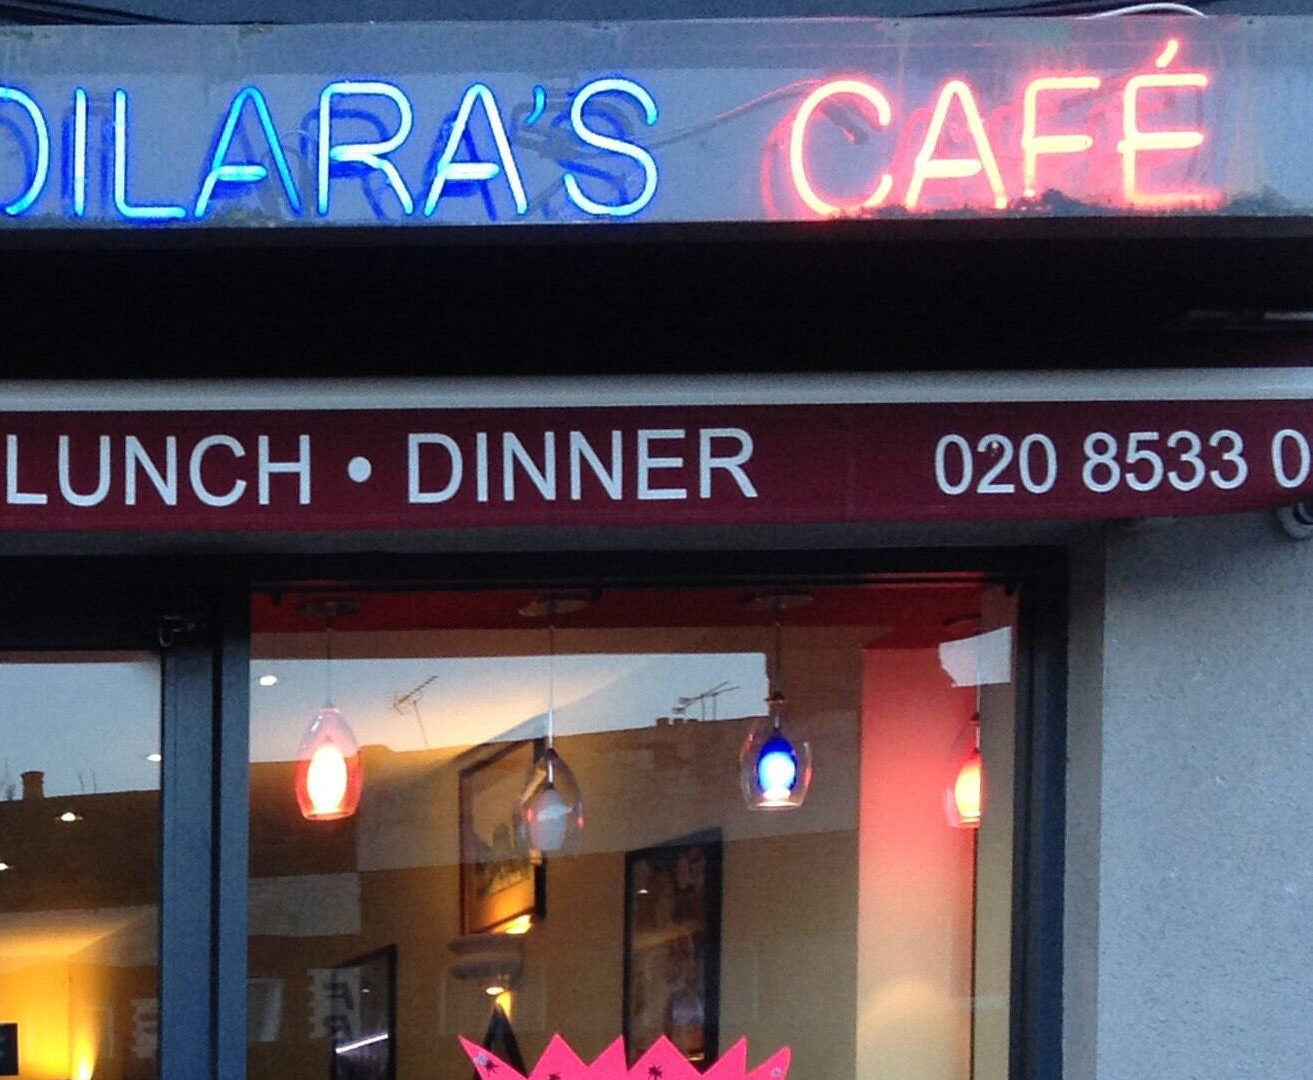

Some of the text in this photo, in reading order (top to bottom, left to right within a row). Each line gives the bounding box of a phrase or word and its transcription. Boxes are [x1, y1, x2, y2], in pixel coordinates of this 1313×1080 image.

[788, 38, 1220, 217] CAFÉ
[4, 432, 313, 508] LUNCH
[407, 428, 759, 504] DINNER
[934, 428, 1311, 496] 020 8533 0
